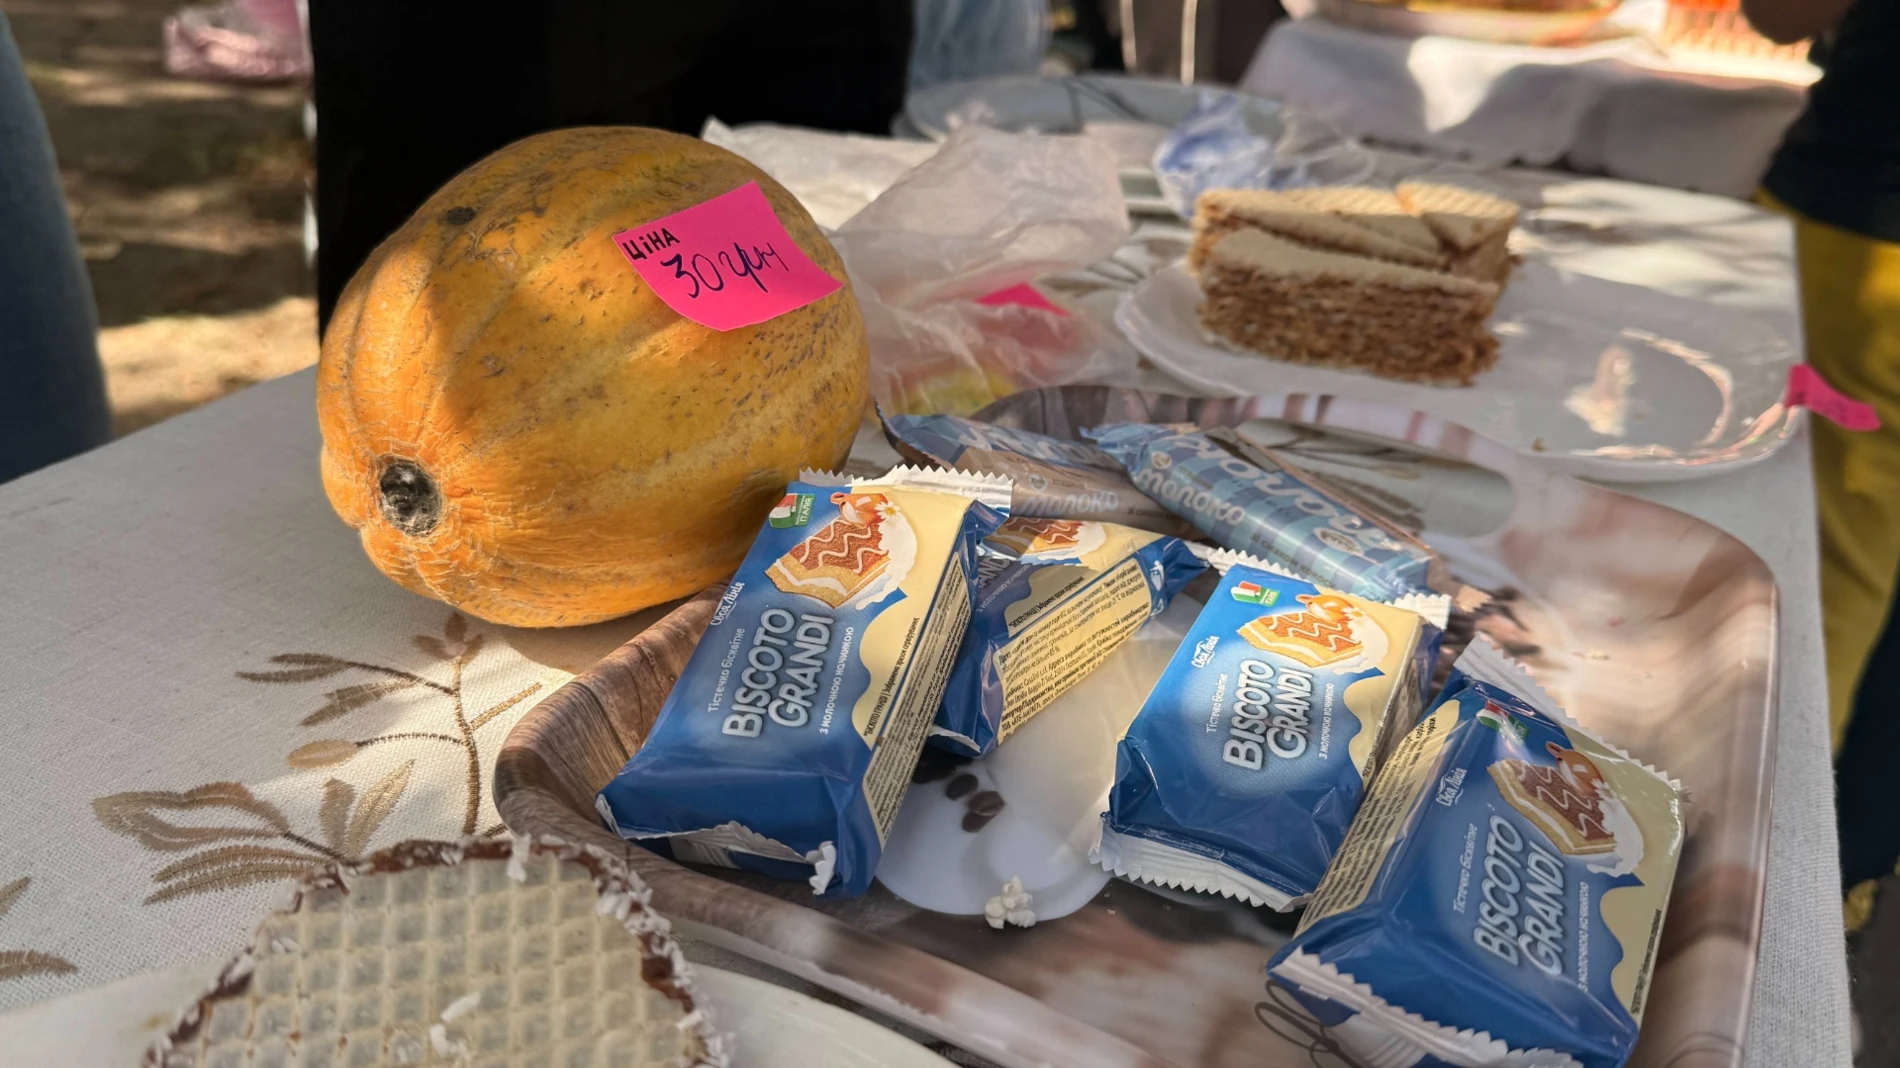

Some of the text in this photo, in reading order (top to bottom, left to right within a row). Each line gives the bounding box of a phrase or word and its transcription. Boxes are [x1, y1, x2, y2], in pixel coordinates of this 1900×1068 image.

[660, 253, 724, 299] 30
[708, 627, 745, 713] Тістечко бісквітне
[721, 608, 796, 739] BISCOTO
[768, 613, 834, 727] GRANDI
[1223, 659, 1275, 771] BISCOTO
[1266, 667, 1313, 759] GRANDI
[1474, 815, 1524, 967] BISCOTO
[1517, 841, 1566, 976] GRANDI
